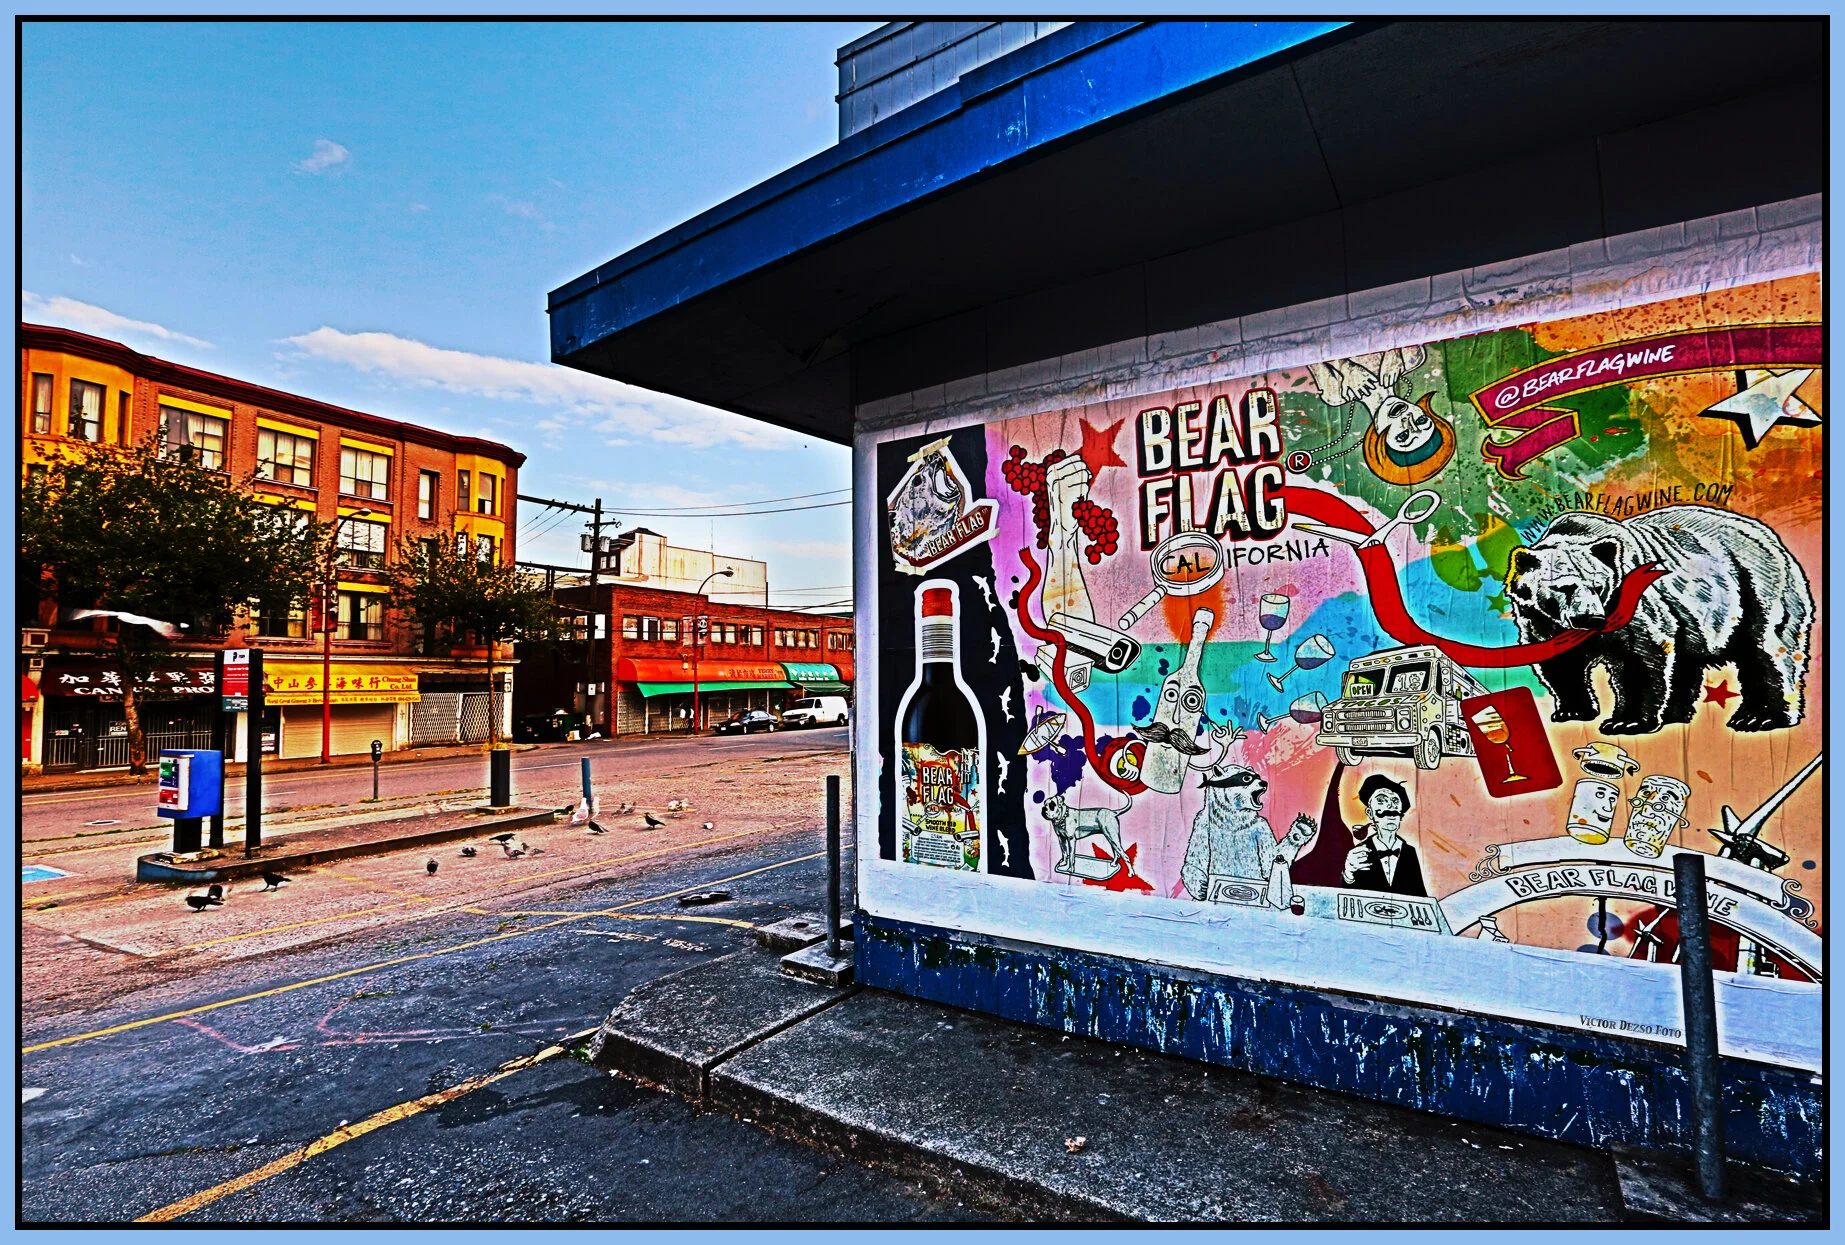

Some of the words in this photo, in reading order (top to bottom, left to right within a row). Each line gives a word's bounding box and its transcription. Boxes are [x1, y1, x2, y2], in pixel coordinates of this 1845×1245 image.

[1494, 344, 1677, 409] @BEARFLAGWINE
[1137, 387, 1285, 478] BEAR
[1139, 463, 1288, 550] FLAG
[1520, 482, 1735, 545] WWW.BEARFLAGWINE.COM
[927, 529, 957, 557] BEAR
[955, 511, 985, 541] FLAG
[1340, 697, 1402, 709] TACOS
[1351, 684, 1372, 695] OPEN
[922, 766, 953, 786] BEAR
[922, 786, 955, 805] FLAG
[1504, 867, 1587, 898] BEAR
[1588, 868, 1657, 894] FLAG
